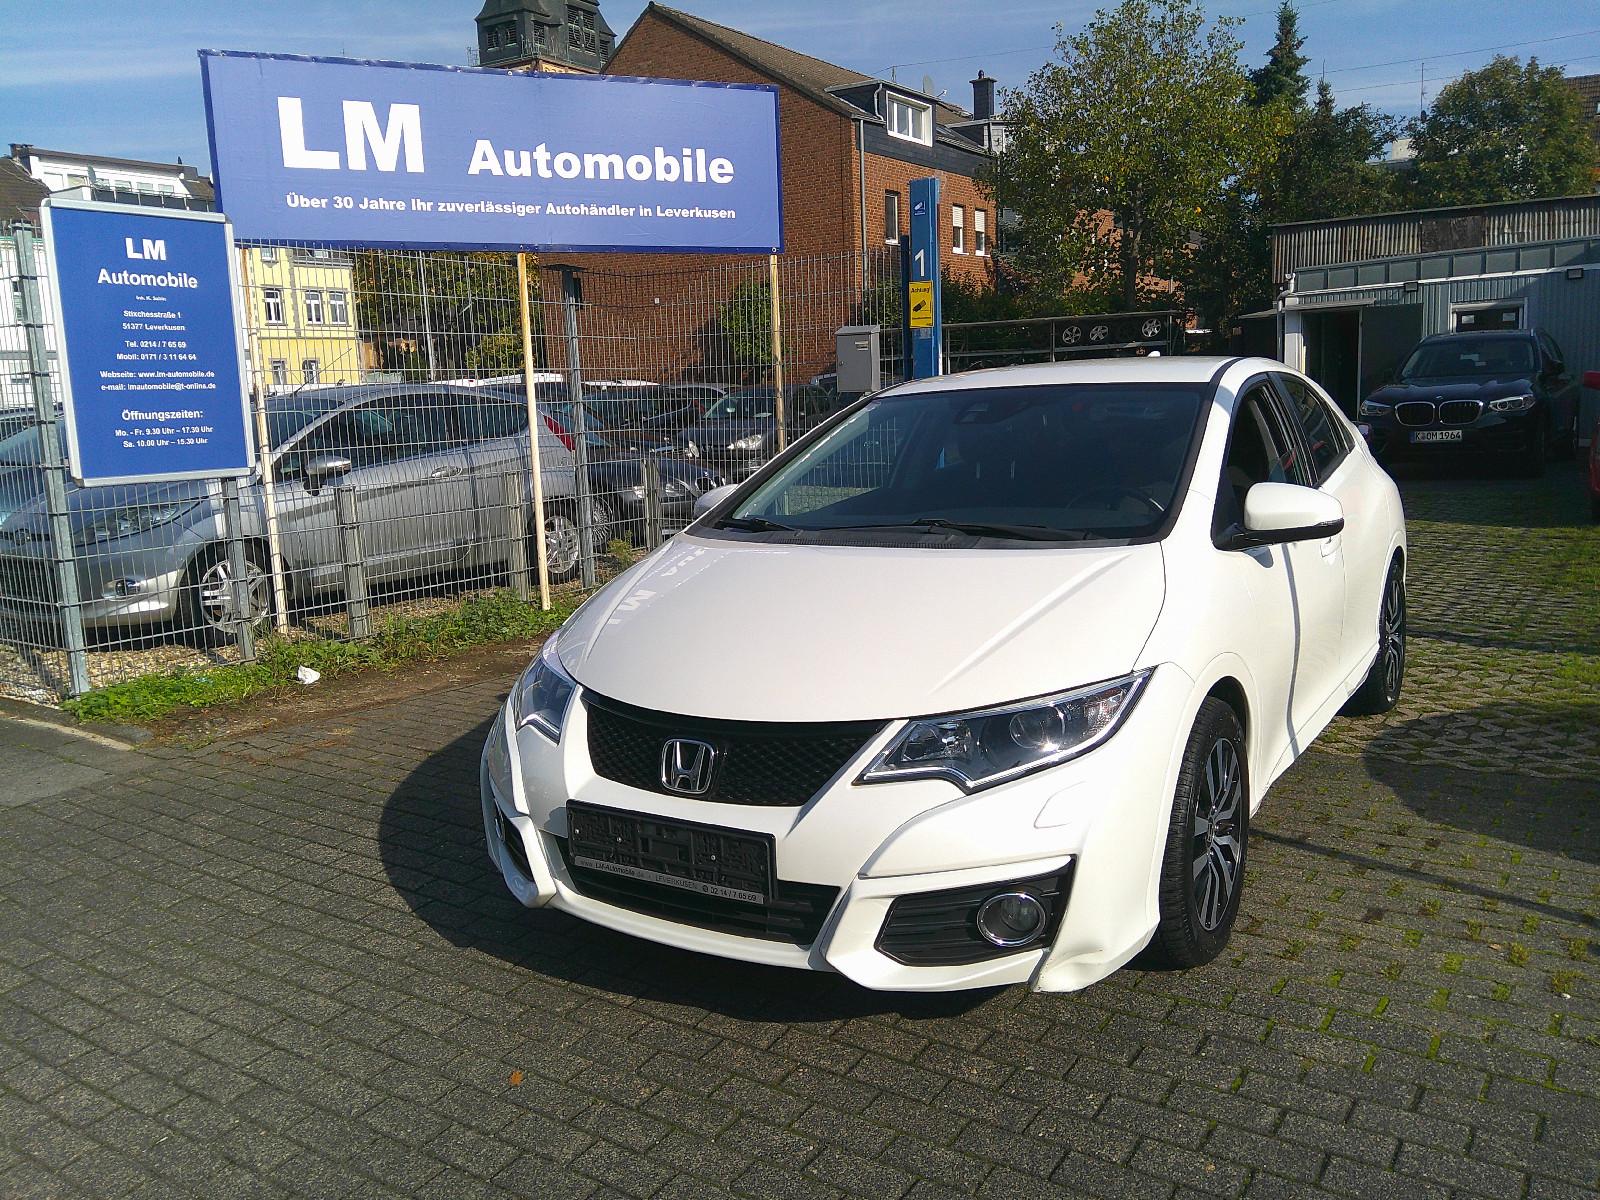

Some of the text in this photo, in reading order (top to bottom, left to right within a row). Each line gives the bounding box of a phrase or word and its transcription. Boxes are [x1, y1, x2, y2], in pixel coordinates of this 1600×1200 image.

[277, 96, 735, 185] LM Automobile
[286, 192, 736, 220] Über 30 Jahre Ihr zuverlässiger Autohändler in Leverkusen
[125, 237, 167, 260] LM
[914, 249, 924, 276] 1
[97, 268, 199, 289] Automobile
[123, 310, 176, 319] Stixchesstraße
[122, 322, 143, 330] 51377
[122, 409, 204, 421] Öffnungszeiten:
[134, 428, 145, 436] Fr.
[181, 426, 200, 434] 17.30
[1440, 431, 1461, 439] 1964
[123, 440, 135, 448] Sa.
